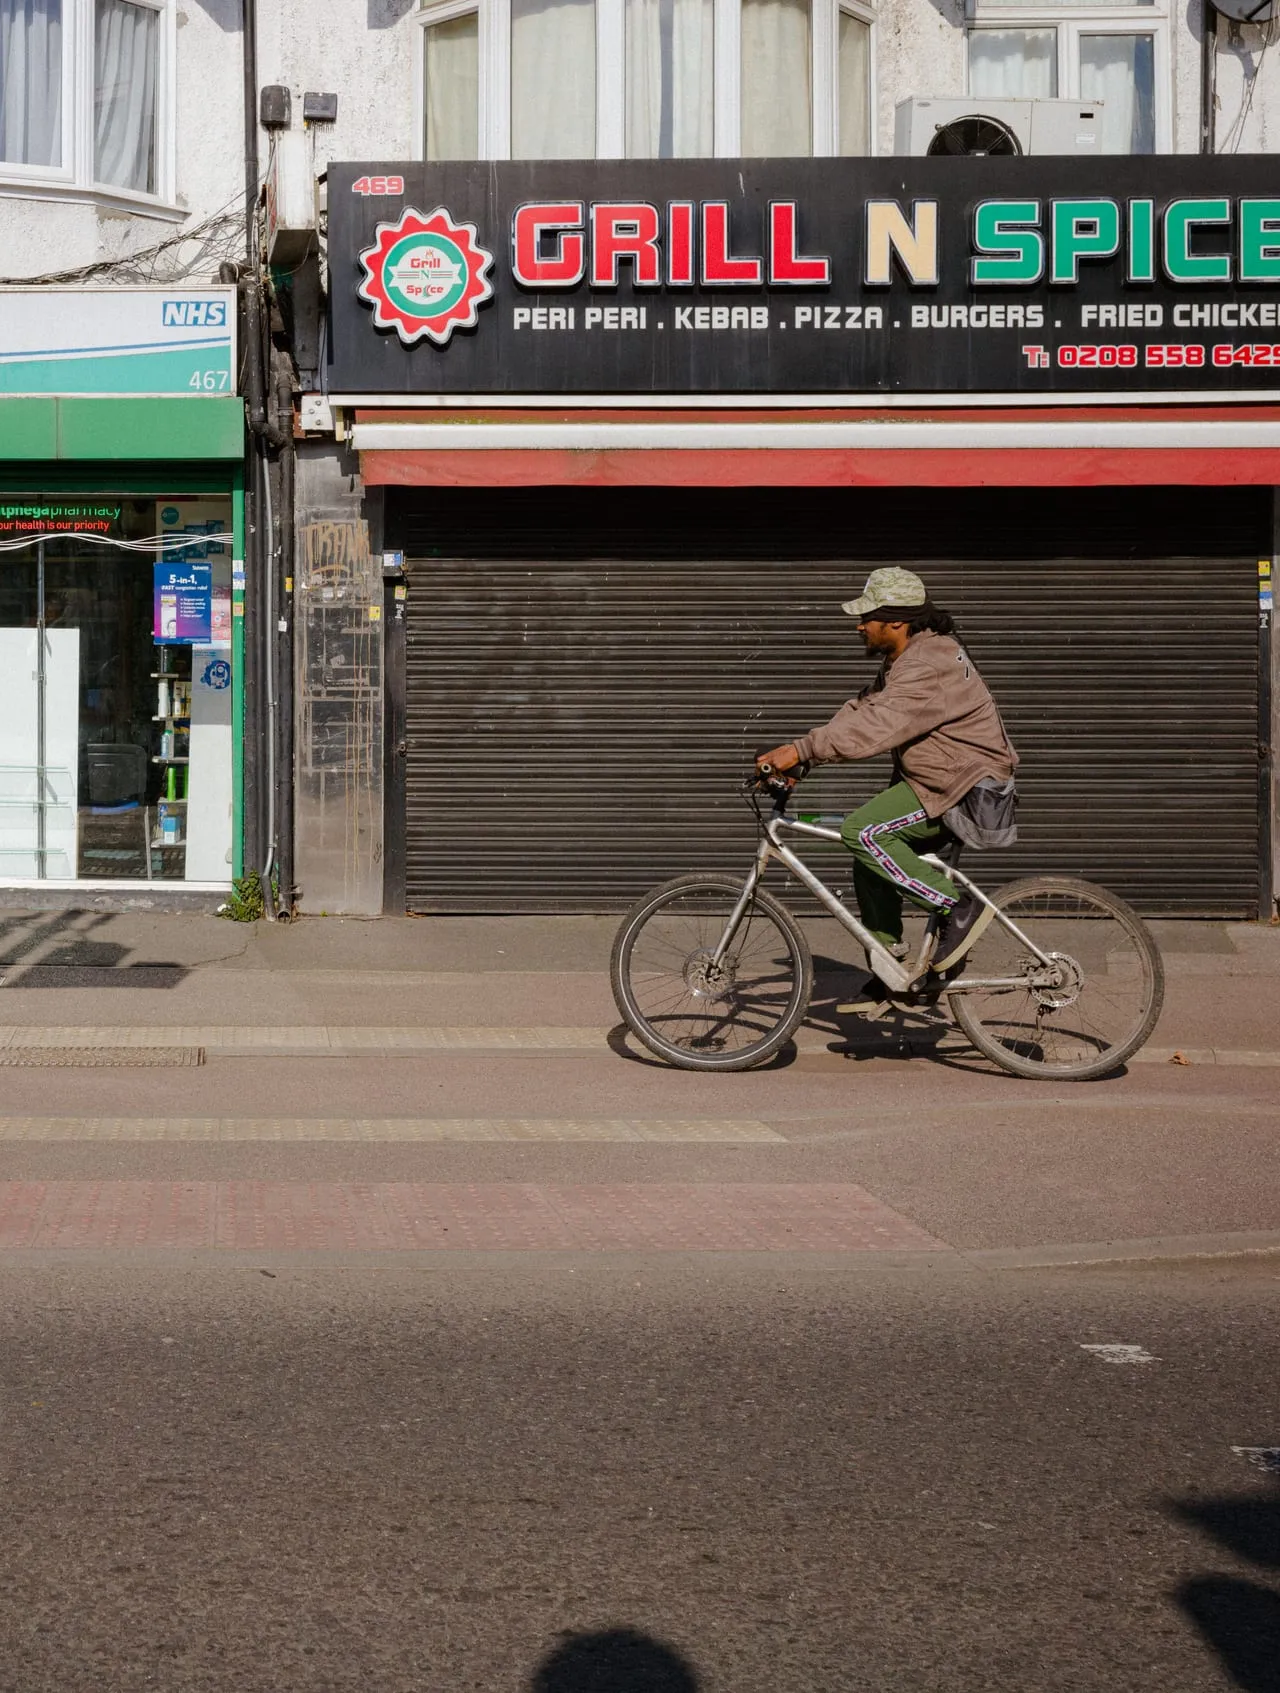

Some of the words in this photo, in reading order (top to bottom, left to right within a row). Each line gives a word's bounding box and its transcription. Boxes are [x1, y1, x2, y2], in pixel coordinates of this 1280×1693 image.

[352, 176, 404, 195] 469
[512, 201, 831, 286] GRILL
[864, 199, 939, 285] N
[971, 197, 1280, 284] SPICE
[410, 258, 441, 268] Grill
[164, 303, 225, 325] NHS
[514, 307, 575, 330] PERI
[584, 307, 646, 329] PERI
[675, 306, 769, 329] KEBAB
[795, 306, 883, 329] PIZZA
[911, 304, 1044, 328] BURGERS
[1081, 304, 1164, 328] FRIED
[1057, 345, 1138, 368] 0208
[1145, 345, 1205, 368] 558
[189, 371, 229, 389] 467
[15, 520, 45, 530] health
[47, 520, 55, 530] is
[56, 522, 72, 530] our
[74, 520, 110, 532] priority
